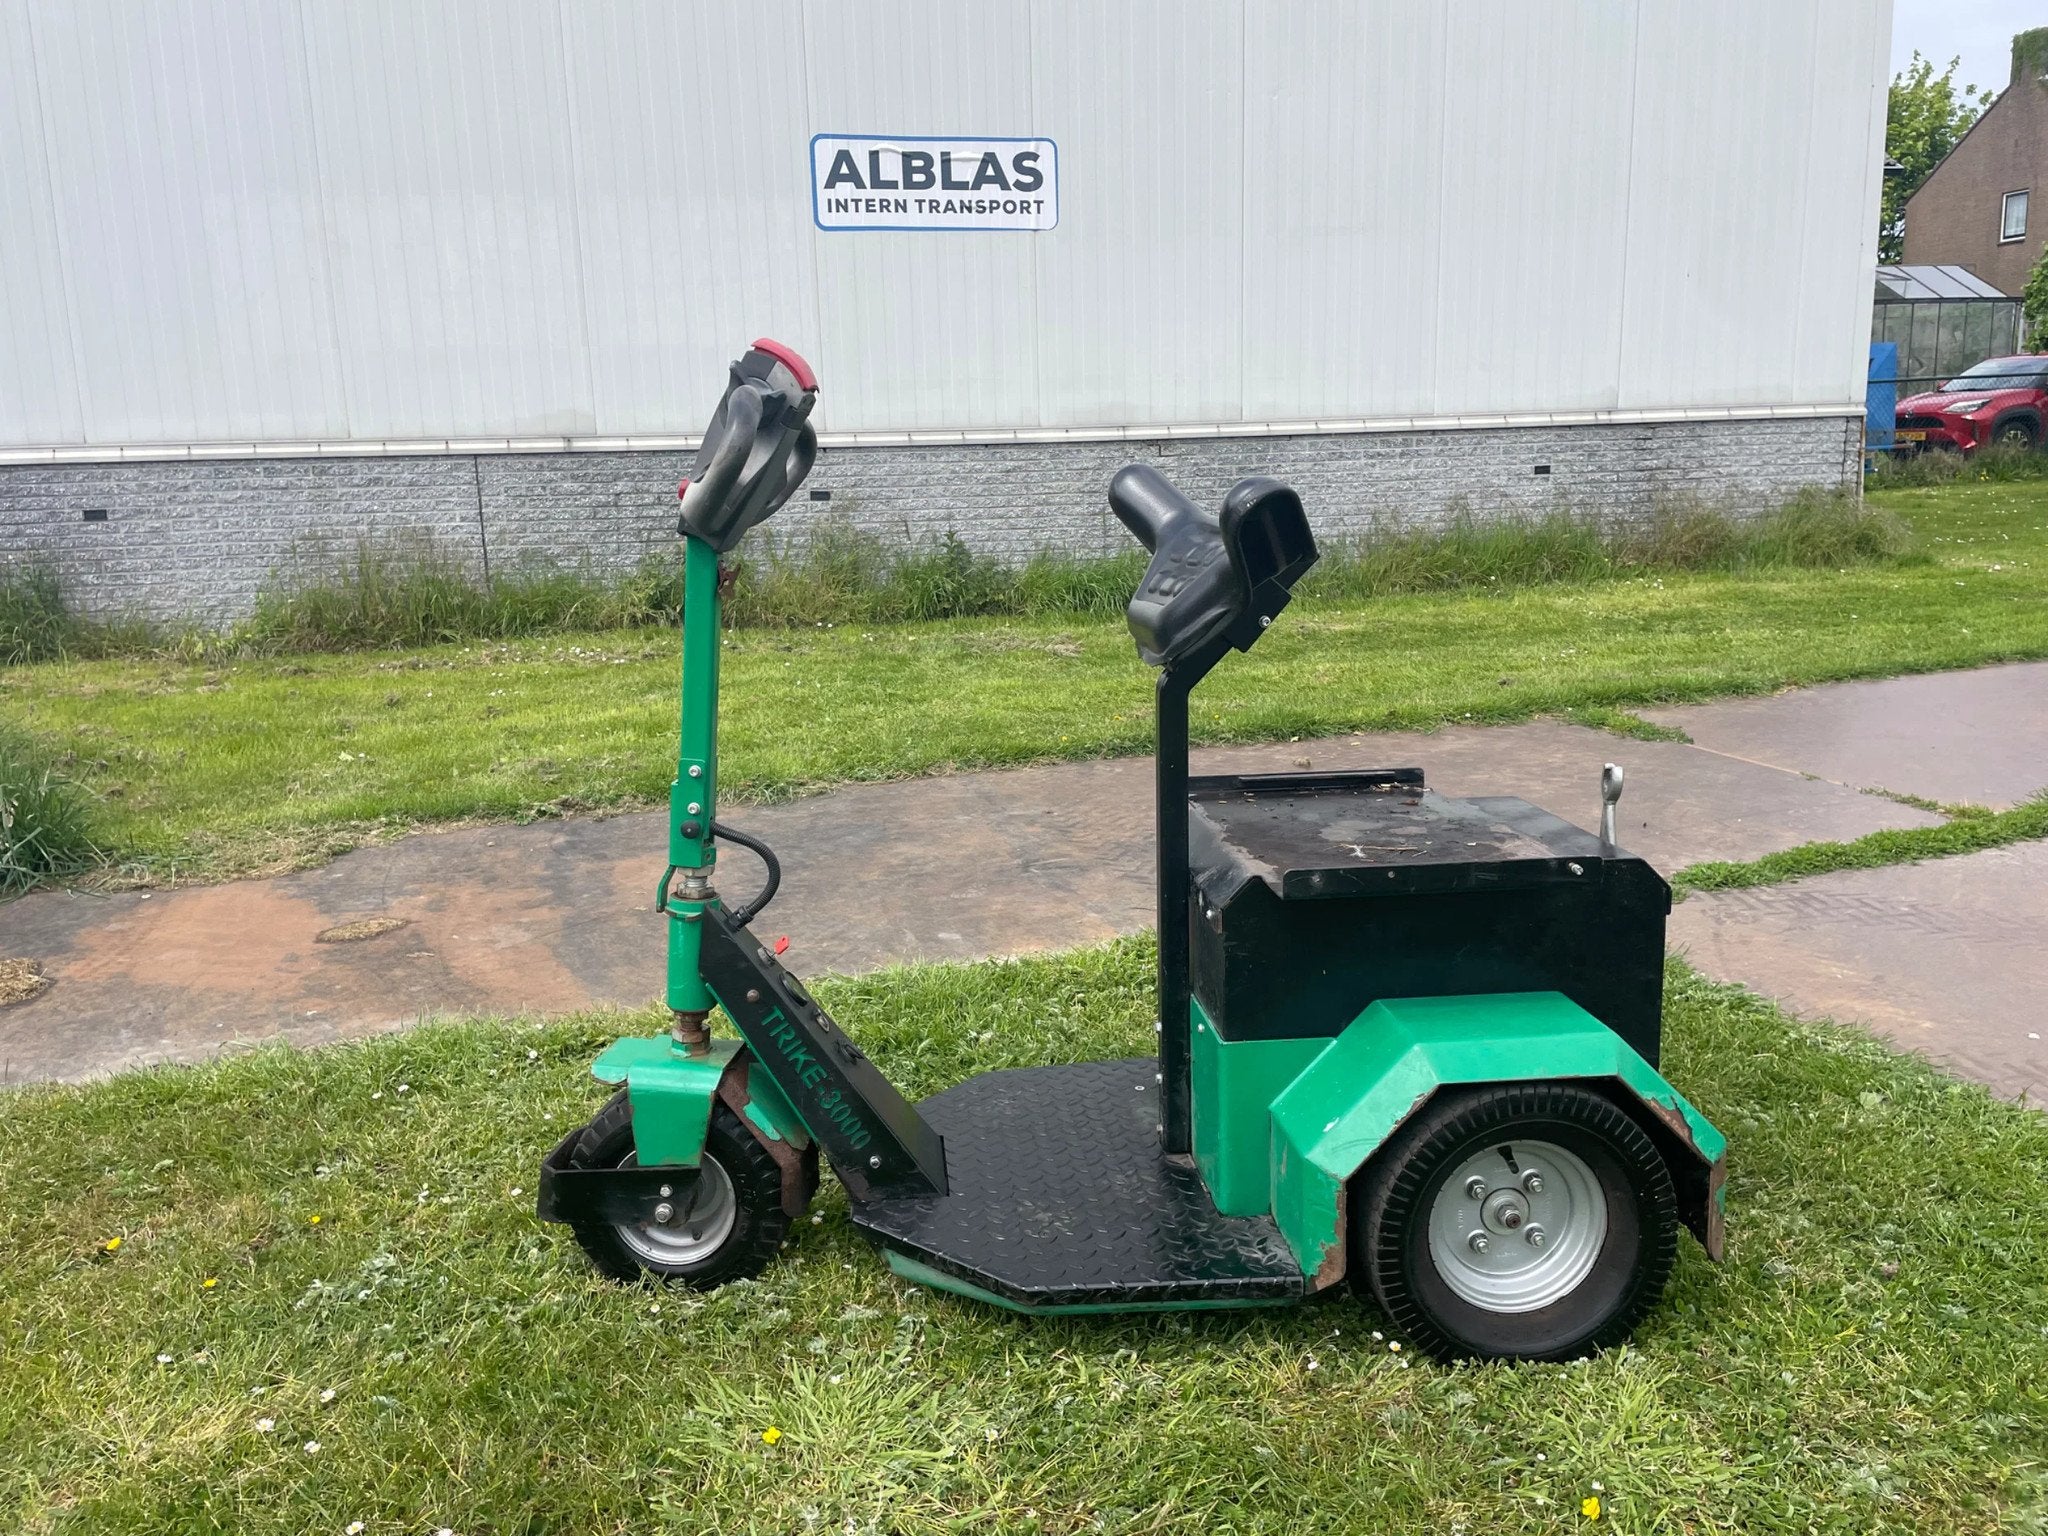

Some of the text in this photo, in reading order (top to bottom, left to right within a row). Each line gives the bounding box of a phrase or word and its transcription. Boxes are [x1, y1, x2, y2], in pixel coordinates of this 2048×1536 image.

[824, 149, 1044, 192] ALBLAS
[827, 198, 1044, 215] INTERN TRANSPORT
